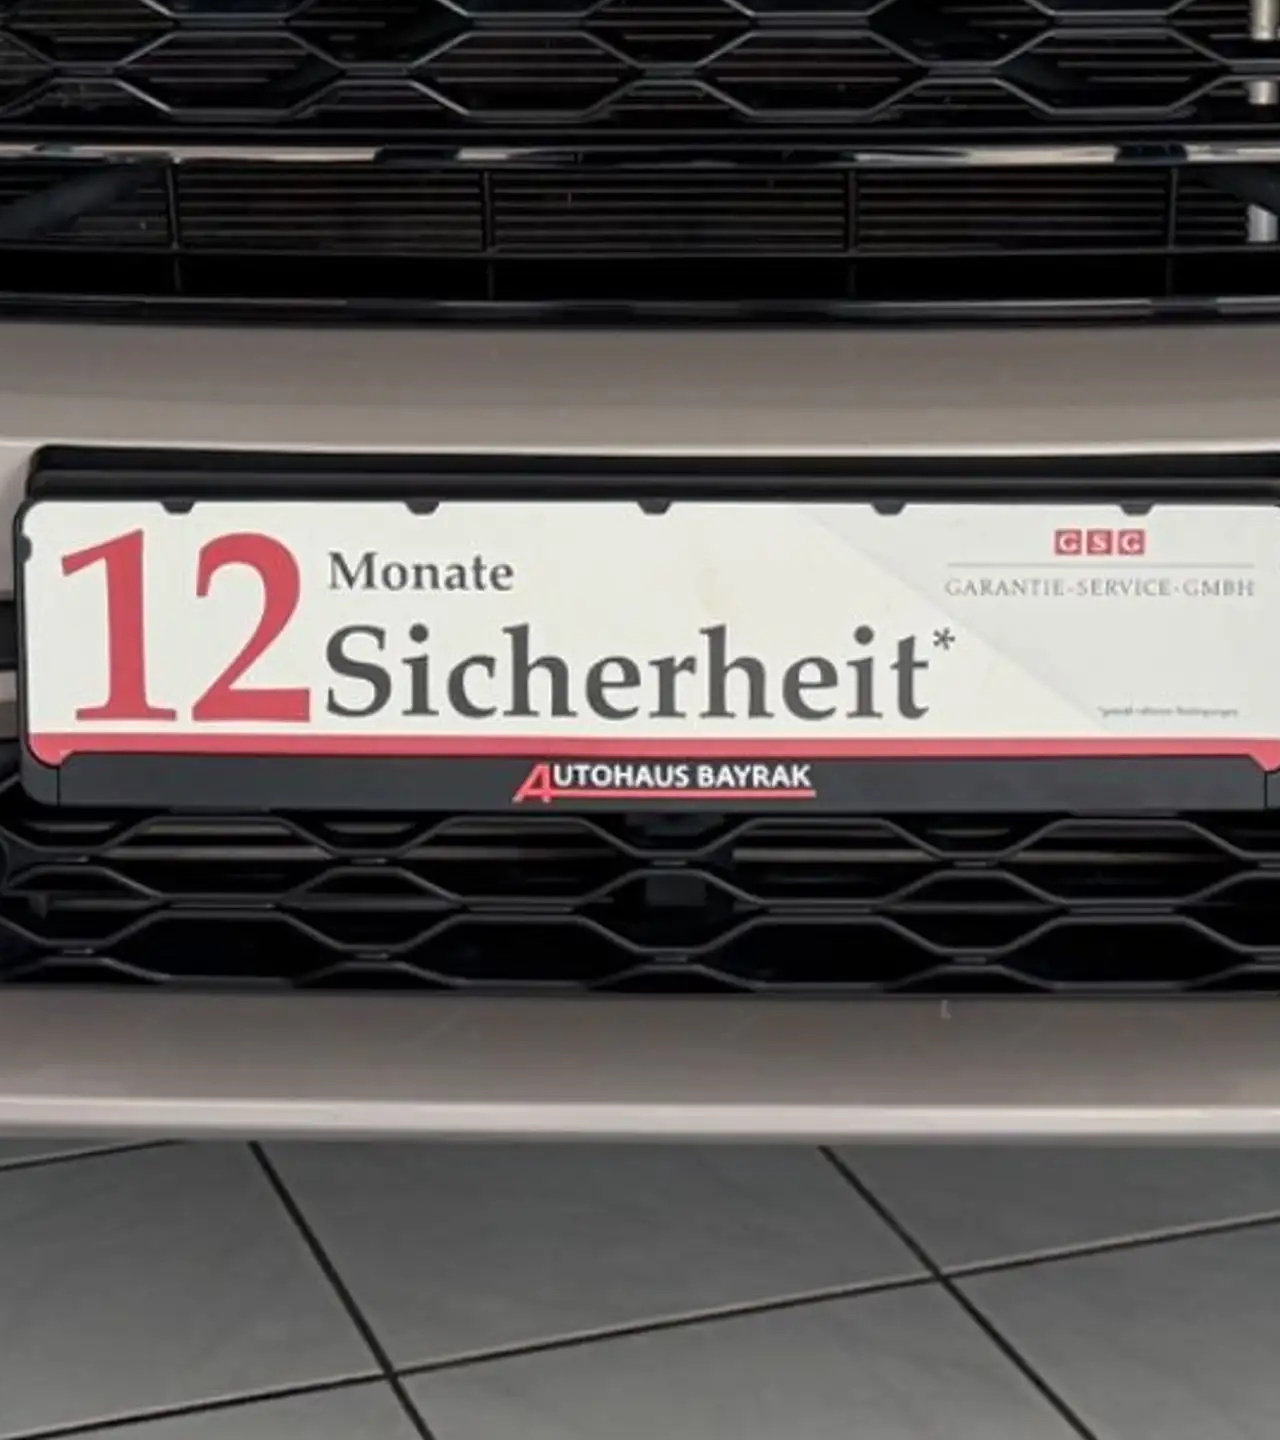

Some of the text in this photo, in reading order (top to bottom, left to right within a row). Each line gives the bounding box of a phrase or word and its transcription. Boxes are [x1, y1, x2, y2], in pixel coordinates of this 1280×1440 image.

[1054, 529, 1145, 555] GSG
[328, 551, 515, 591] Monate
[62, 529, 311, 722] 12
[512, 763, 813, 803] AUTOHAUS BAYRAK
